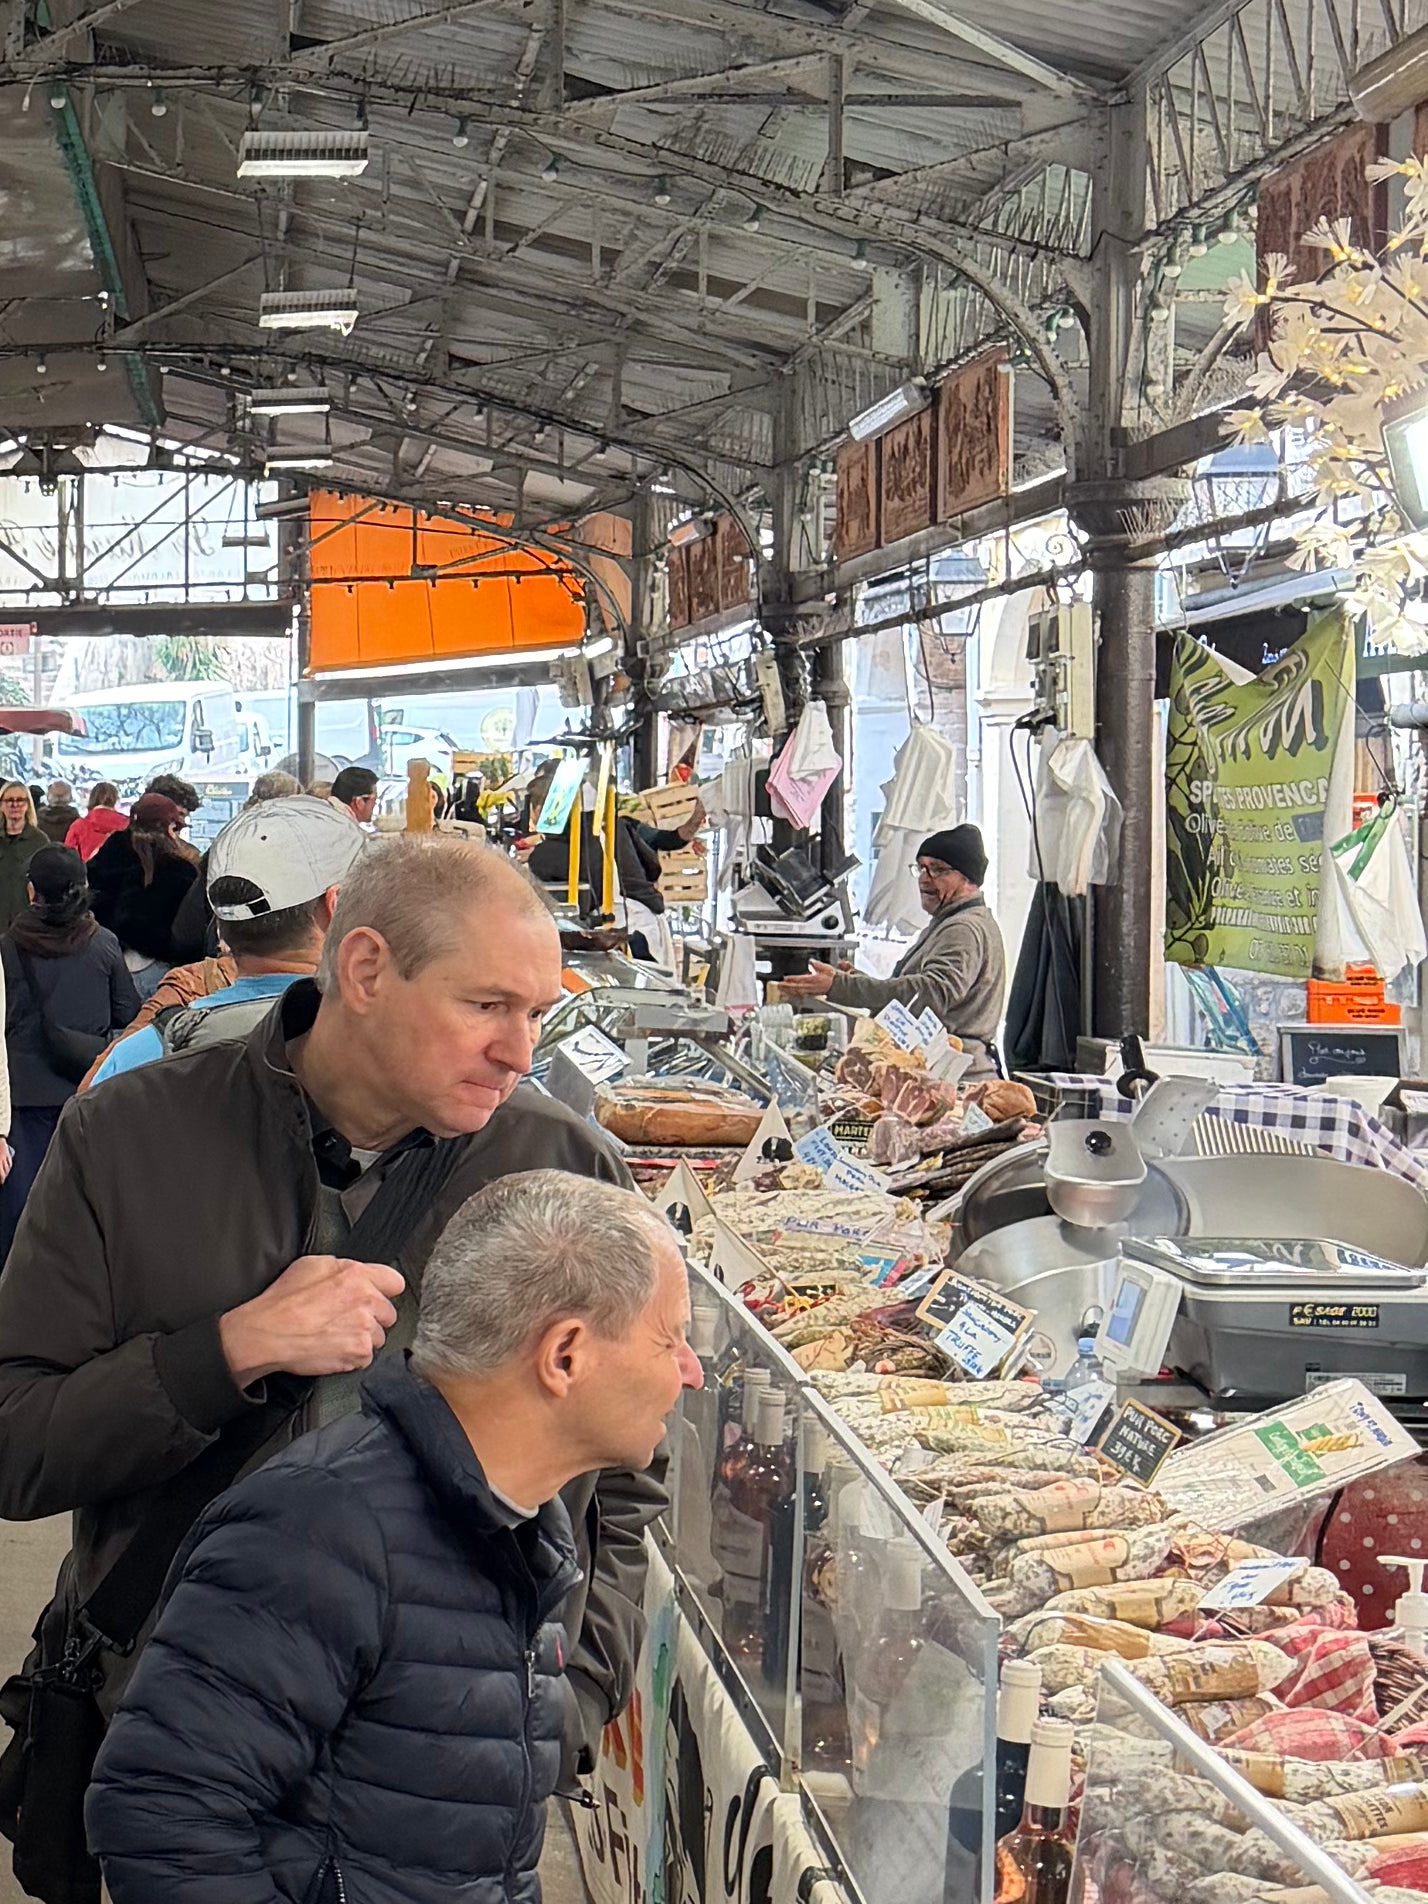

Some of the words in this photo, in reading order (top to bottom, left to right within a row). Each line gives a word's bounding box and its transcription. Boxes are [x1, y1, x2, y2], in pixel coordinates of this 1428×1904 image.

[1351, 1306, 1378, 1317] 2000
[1123, 1406, 1144, 1429] PUR
[1118, 1425, 1158, 1457] NATURE
